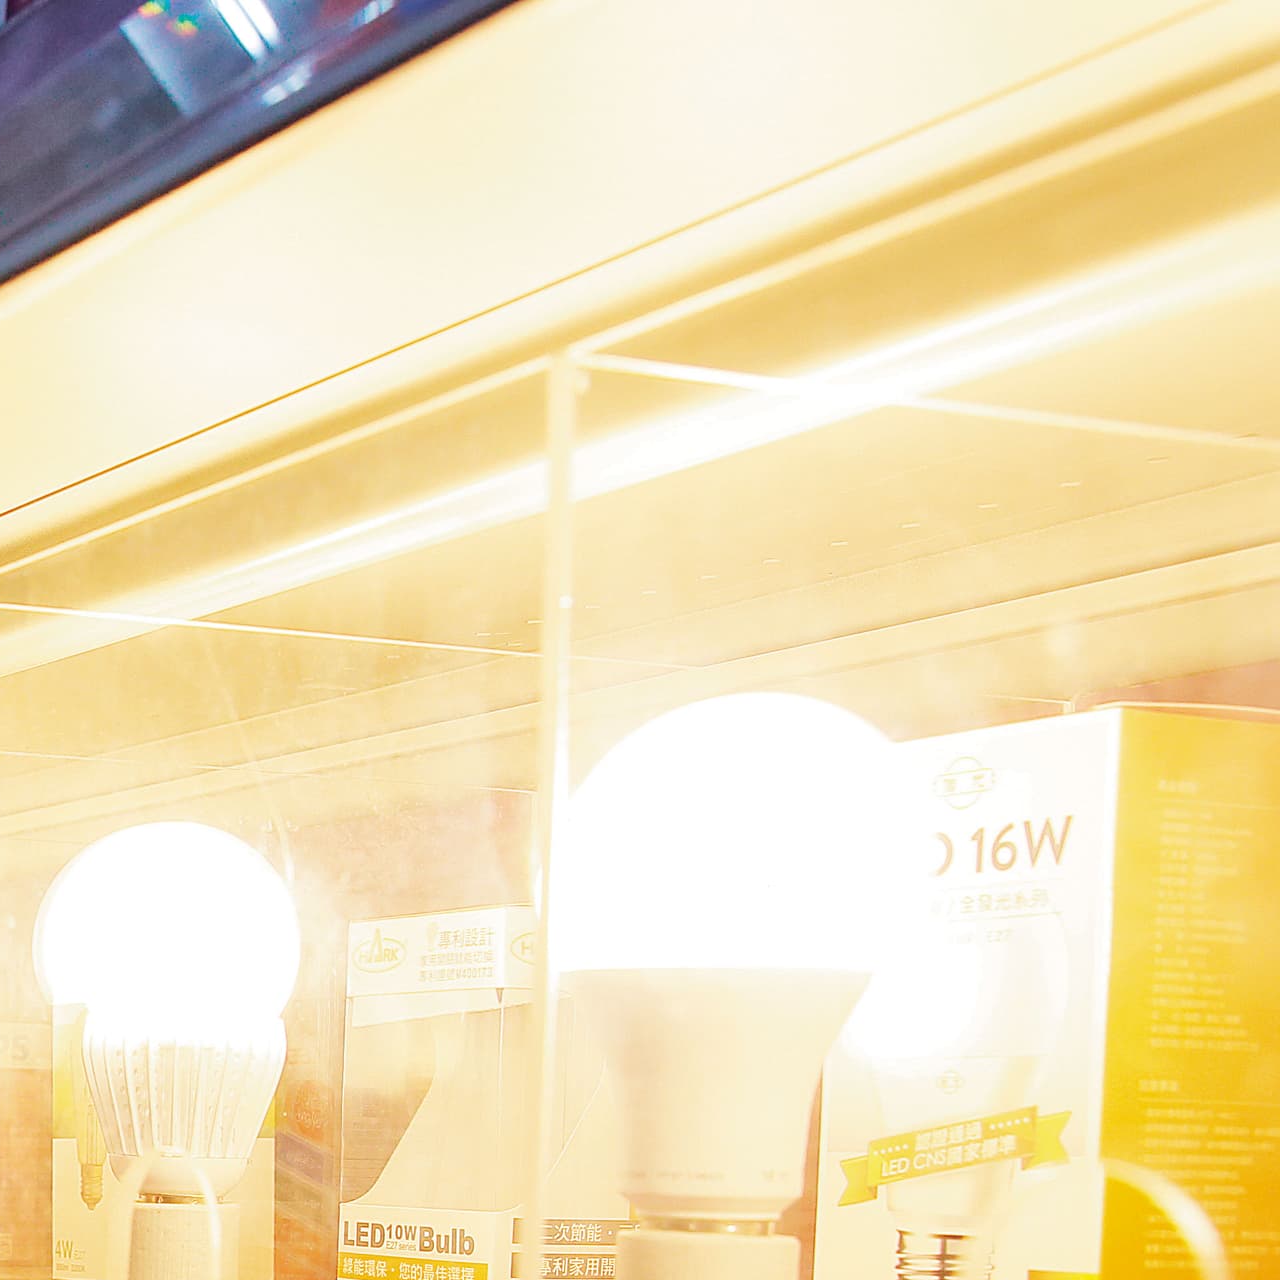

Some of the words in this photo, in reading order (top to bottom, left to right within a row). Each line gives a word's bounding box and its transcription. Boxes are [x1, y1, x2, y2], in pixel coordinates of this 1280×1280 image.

[970, 815, 1074, 874] 16W
[438, 927, 495, 948] 專利設計
[880, 1156, 911, 1178] LED
[343, 1220, 385, 1248] LED
[386, 1223, 418, 1242] 10W
[418, 1226, 475, 1256] Bulb
[55, 1239, 74, 1260] 4W
